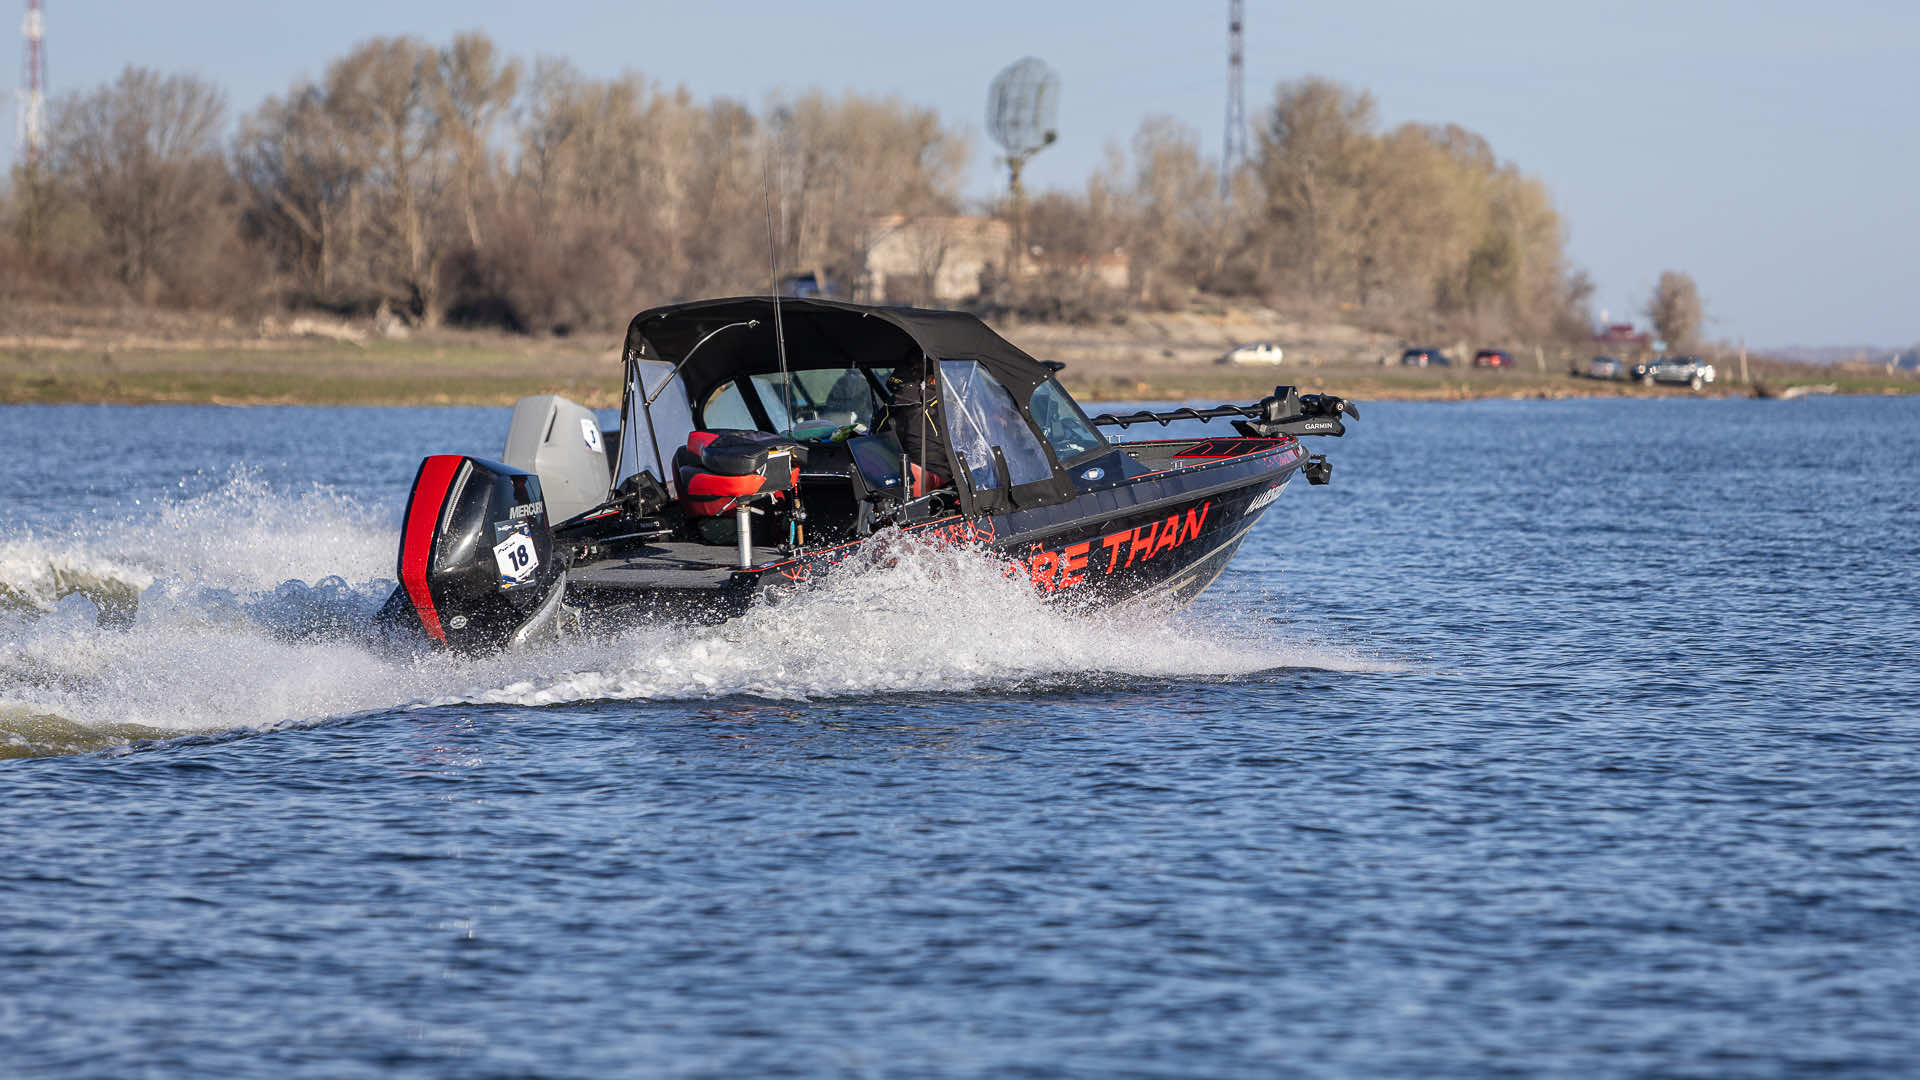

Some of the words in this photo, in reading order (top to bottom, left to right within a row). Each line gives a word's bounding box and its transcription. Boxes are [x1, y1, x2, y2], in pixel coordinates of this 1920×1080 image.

[1304, 422, 1333, 430] GARMIN
[1102, 502, 1211, 574] THAN
[508, 544, 529, 571] 18
